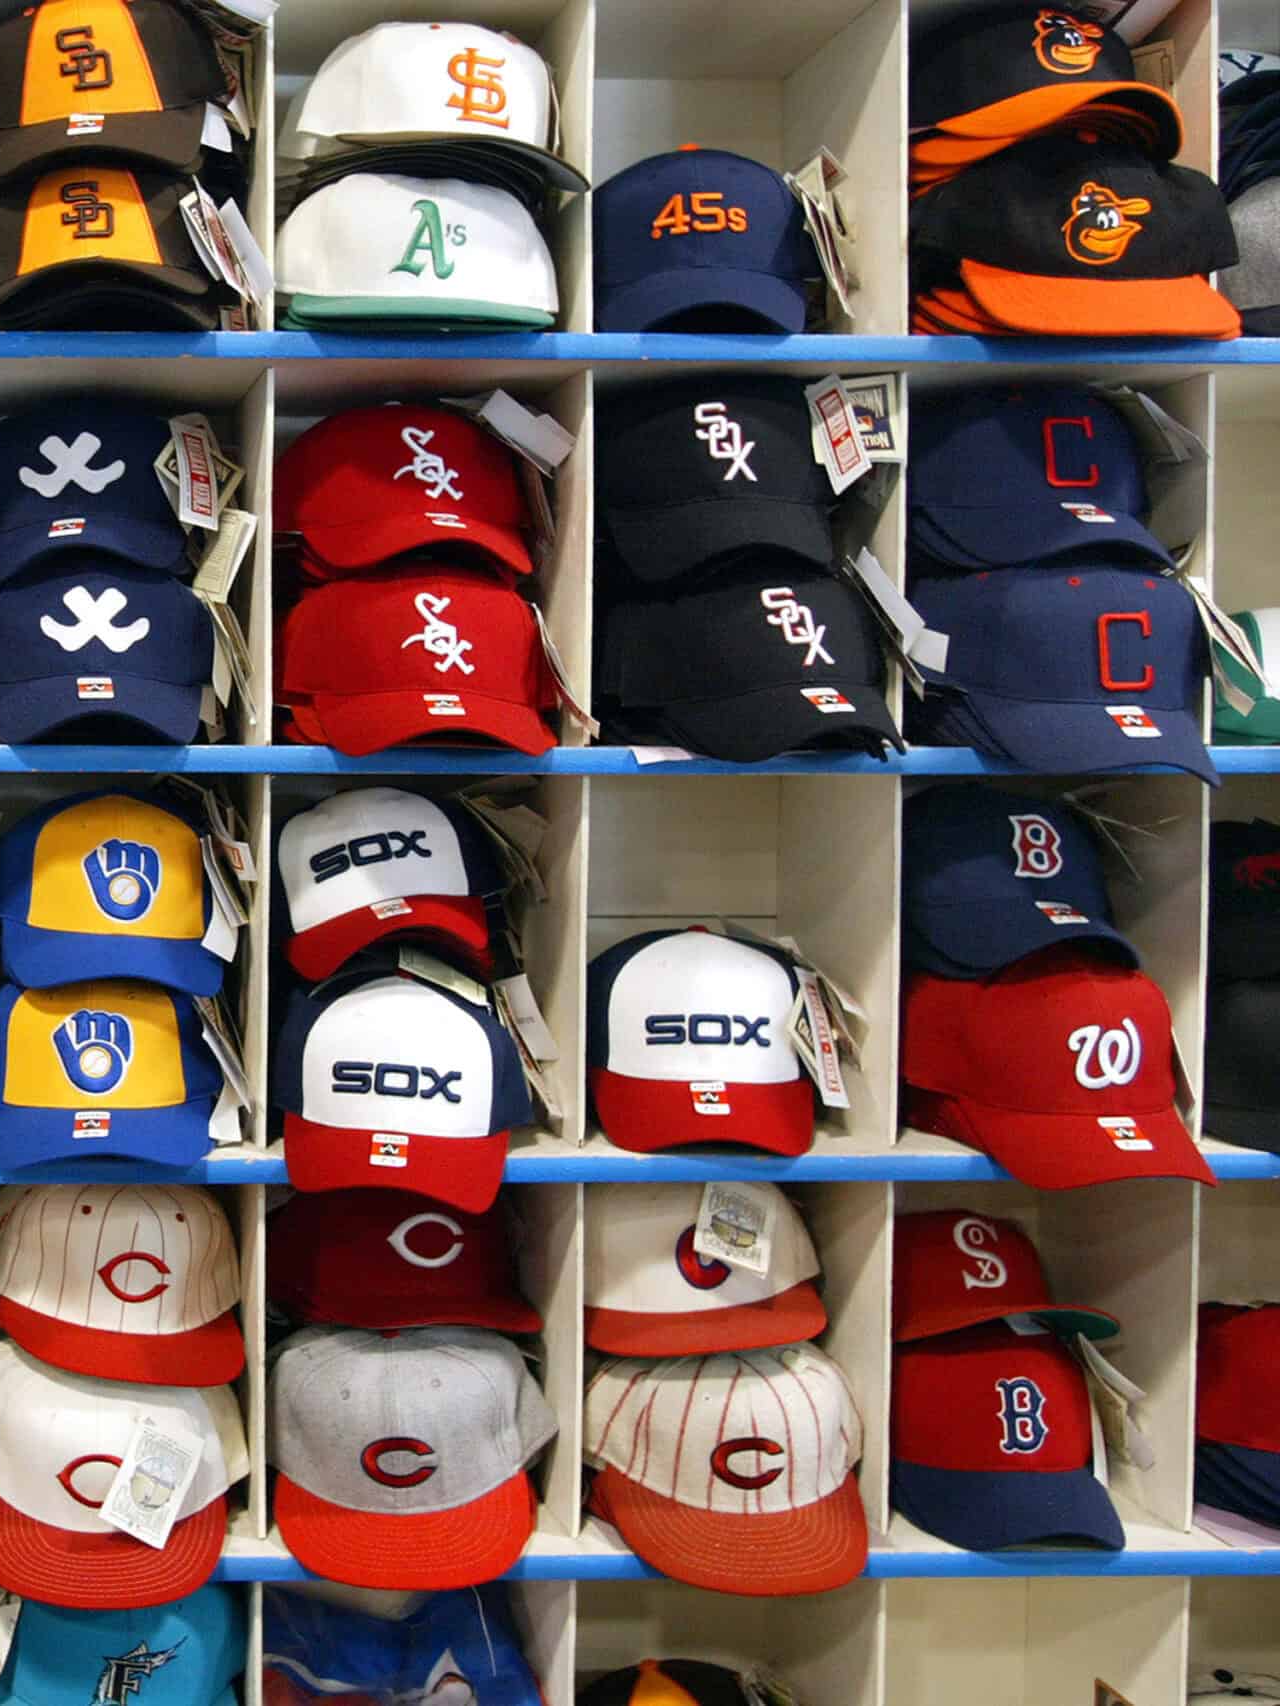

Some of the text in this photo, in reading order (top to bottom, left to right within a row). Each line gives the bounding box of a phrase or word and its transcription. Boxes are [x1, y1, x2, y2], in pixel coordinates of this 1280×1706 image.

[56, 26, 113, 91] SD
[61, 181, 114, 239] SD
[1042, 415, 1099, 487] C
[1096, 609, 1154, 691] C
[310, 830, 433, 884] SOX
[1008, 813, 1063, 879] B
[645, 1013, 770, 1049] SOX
[1067, 1016, 1142, 1090] W
[332, 1062, 462, 1104] SOX
[387, 1213, 464, 1268] C
[98, 1251, 171, 1303] C
[995, 1376, 1049, 1453] B
[360, 1436, 438, 1489] C
[710, 1437, 784, 1490] C
